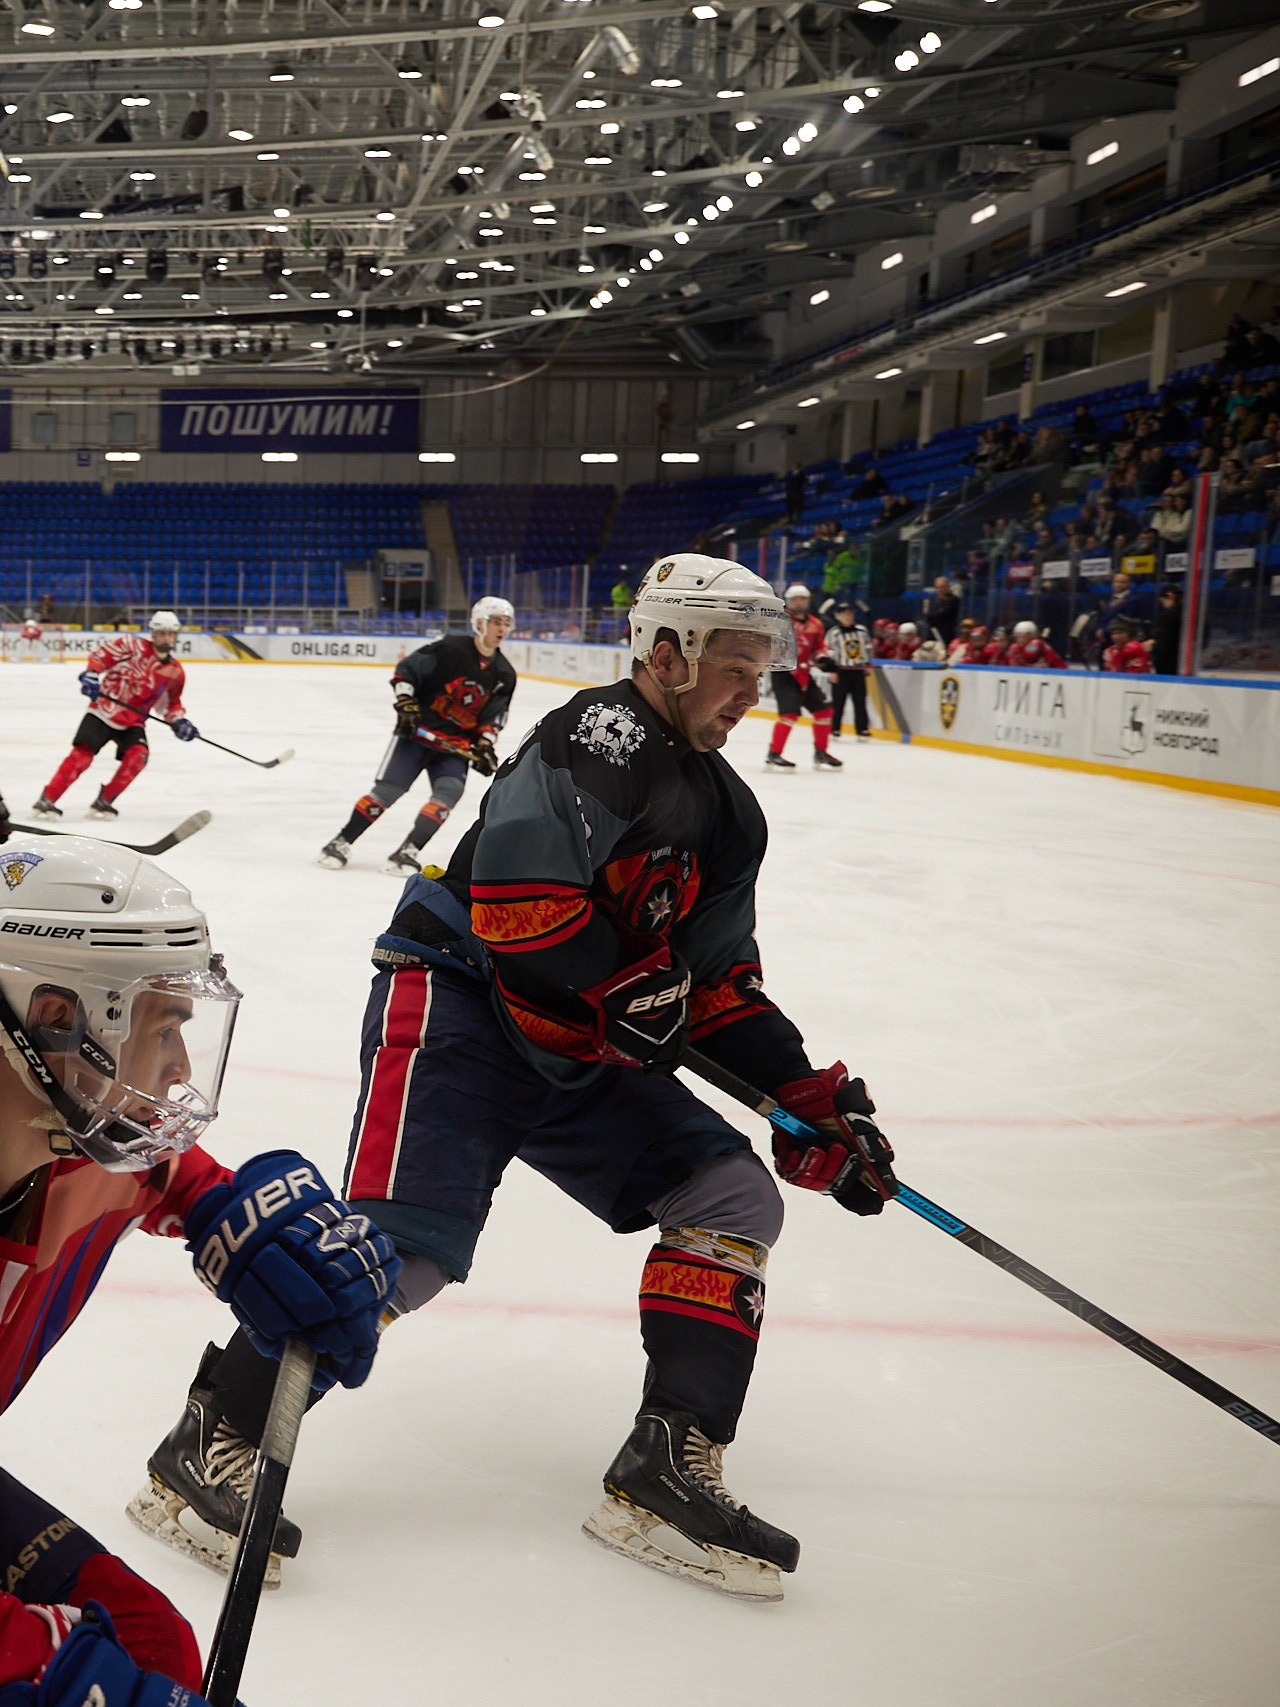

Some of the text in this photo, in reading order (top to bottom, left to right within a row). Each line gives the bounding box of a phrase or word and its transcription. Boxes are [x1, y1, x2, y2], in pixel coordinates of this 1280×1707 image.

[180, 405, 393, 436] ПОШУМИМ!
[292, 641, 376, 658] OHLIGA.RU
[993, 679, 1066, 719] ЛИГА
[1154, 708, 1210, 728] НИЖНИЙ
[1152, 732, 1219, 755] НОВГОРОД
[1, 921, 85, 940] BAUER
[626, 970, 692, 1015] BAU
[13, 1030, 53, 1084] CCM
[82, 1042, 115, 1071] CCM
[659, 1475, 690, 1503] BAUER
[0, 1517, 77, 1594] ASTON
